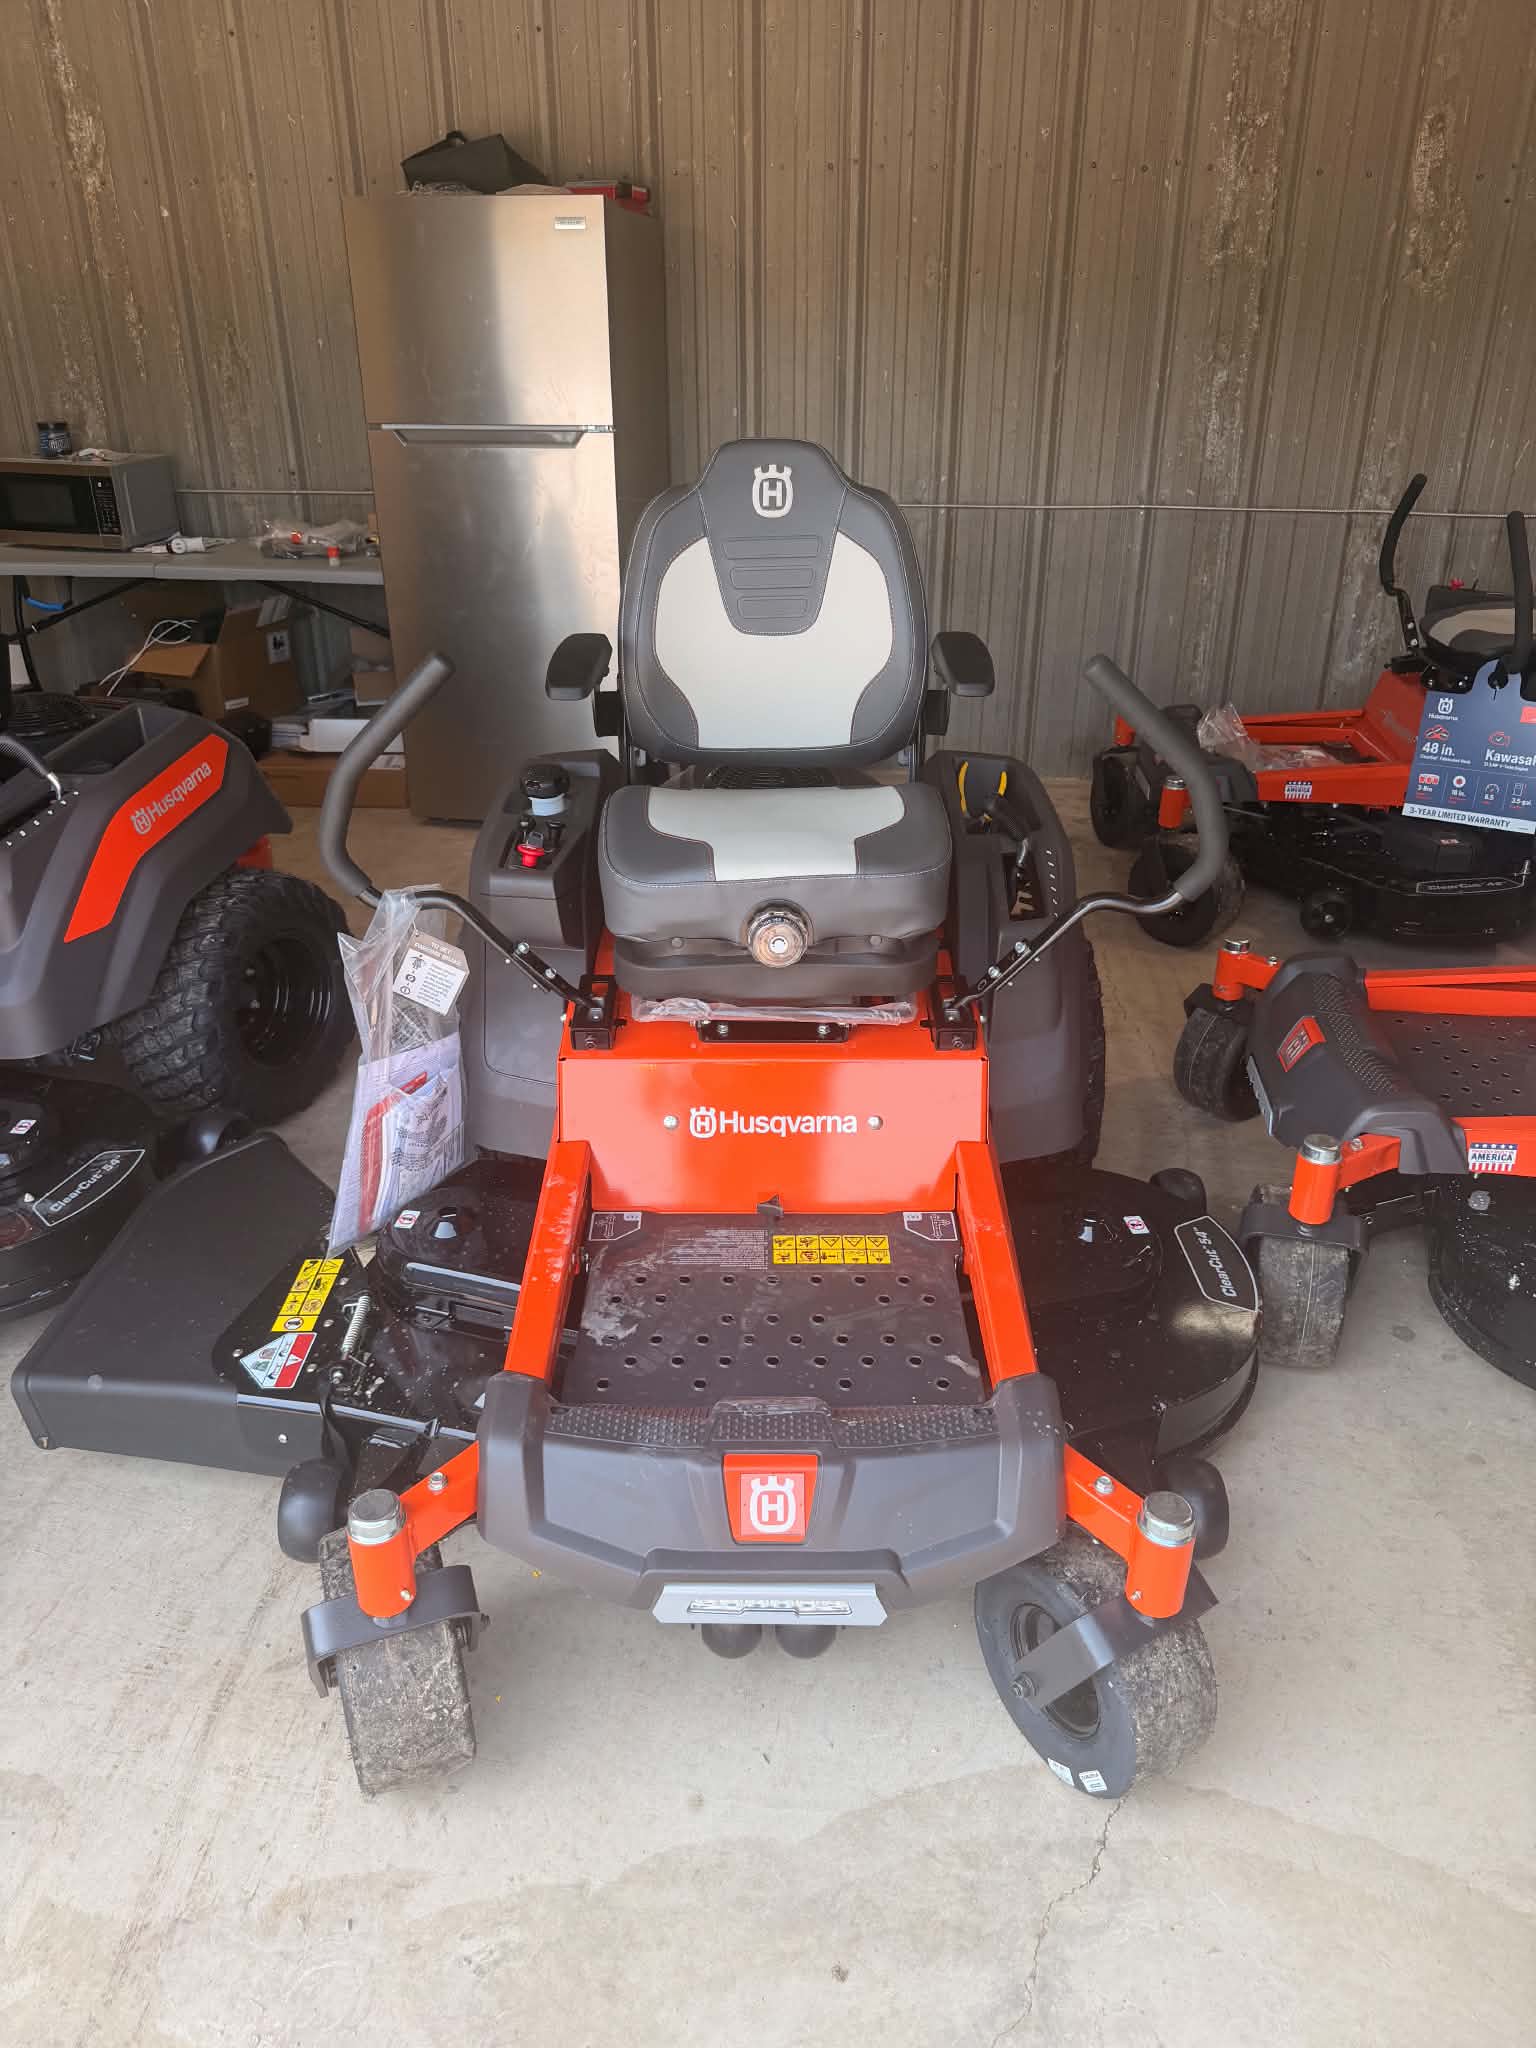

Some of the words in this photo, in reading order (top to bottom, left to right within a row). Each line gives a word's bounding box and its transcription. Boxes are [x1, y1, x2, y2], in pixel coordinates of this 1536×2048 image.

[1422, 742, 1439, 754] 48
[1441, 743, 1456, 756] in.
[145, 761, 212, 822] Husqvarna
[1408, 806, 1437, 817] 3-YEAR
[1437, 812, 1466, 821] LIMITED
[1467, 815, 1511, 828] WARRANTY
[719, 1110, 857, 1138] Husqvarna
[1471, 1153, 1513, 1161] AMERICA
